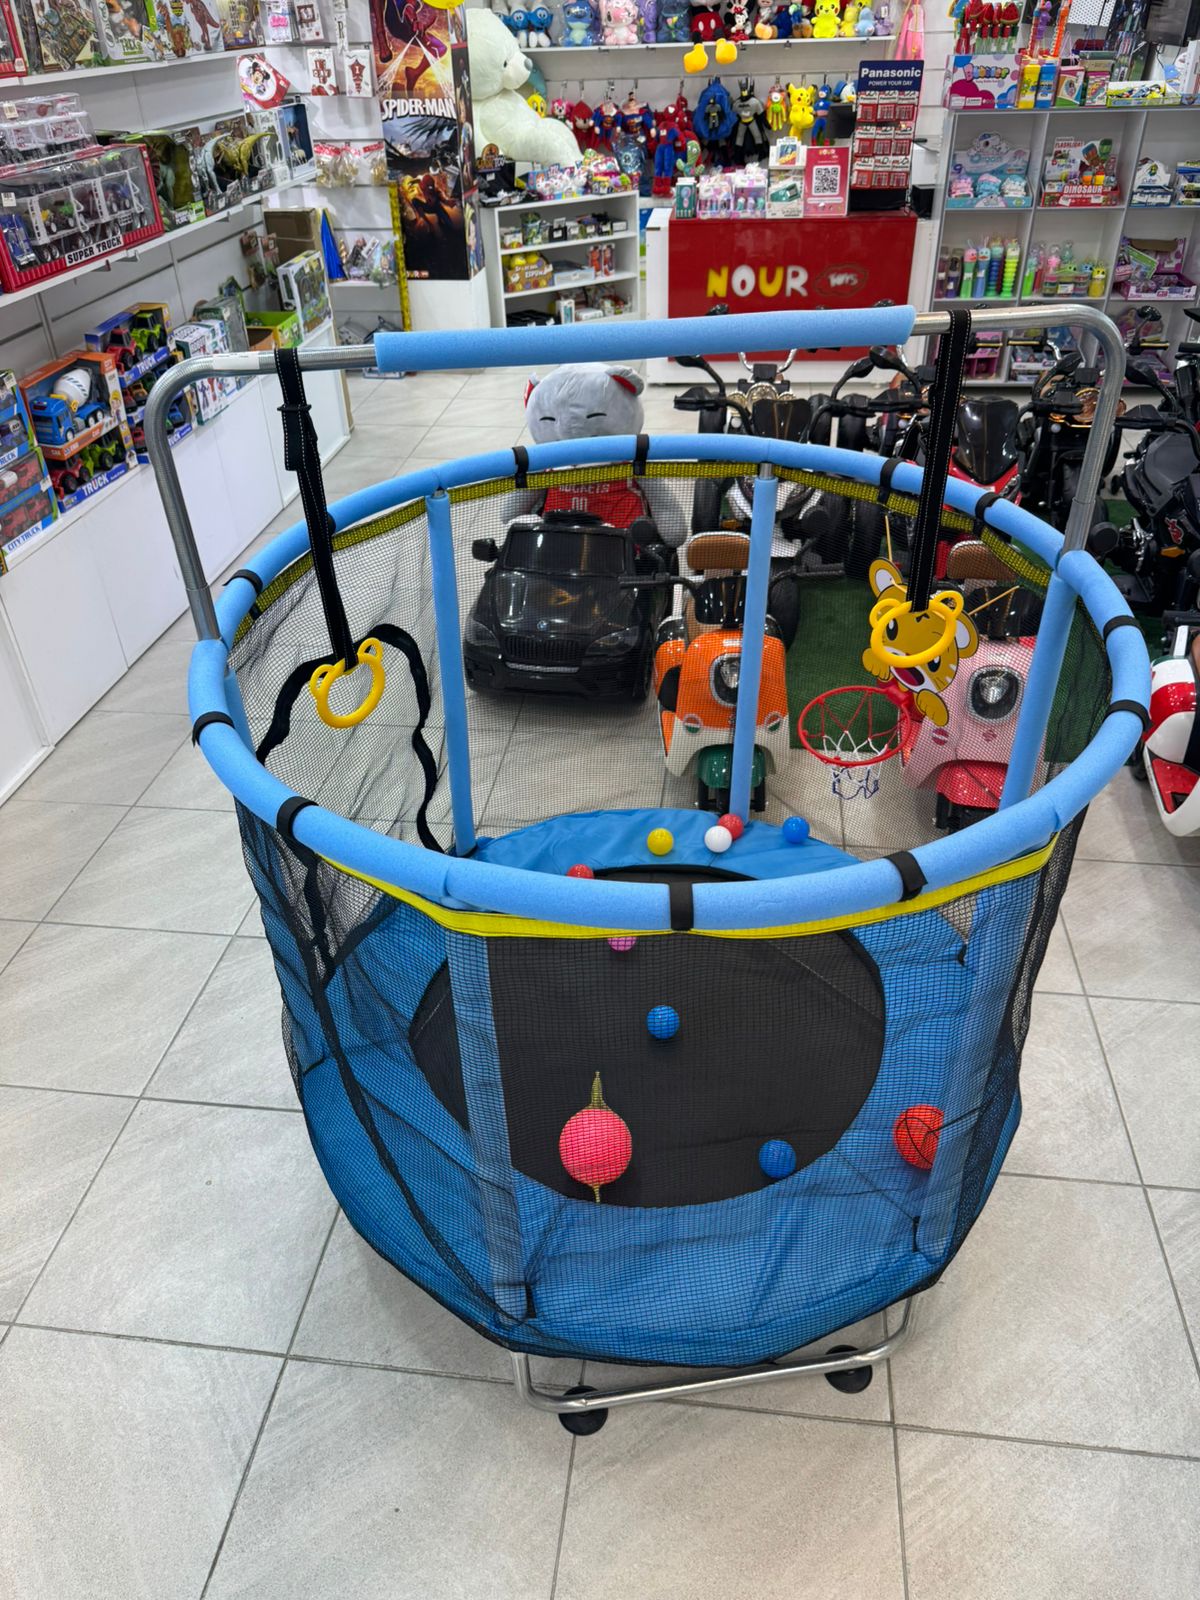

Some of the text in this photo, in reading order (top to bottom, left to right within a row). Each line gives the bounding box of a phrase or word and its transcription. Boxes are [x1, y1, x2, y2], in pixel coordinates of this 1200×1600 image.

[861, 67, 922, 78] Panasonic
[382, 98, 457, 121] SPIDER-MAN
[1063, 185, 1103, 194] DINOSAUR
[67, 236, 122, 264] SUPER TRUCK
[706, 264, 809, 298] NOUR
[136, 354, 156, 374] TRUCK
[82, 473, 110, 496] TRUCK
[7, 525, 41, 553] CITY TRUCK
